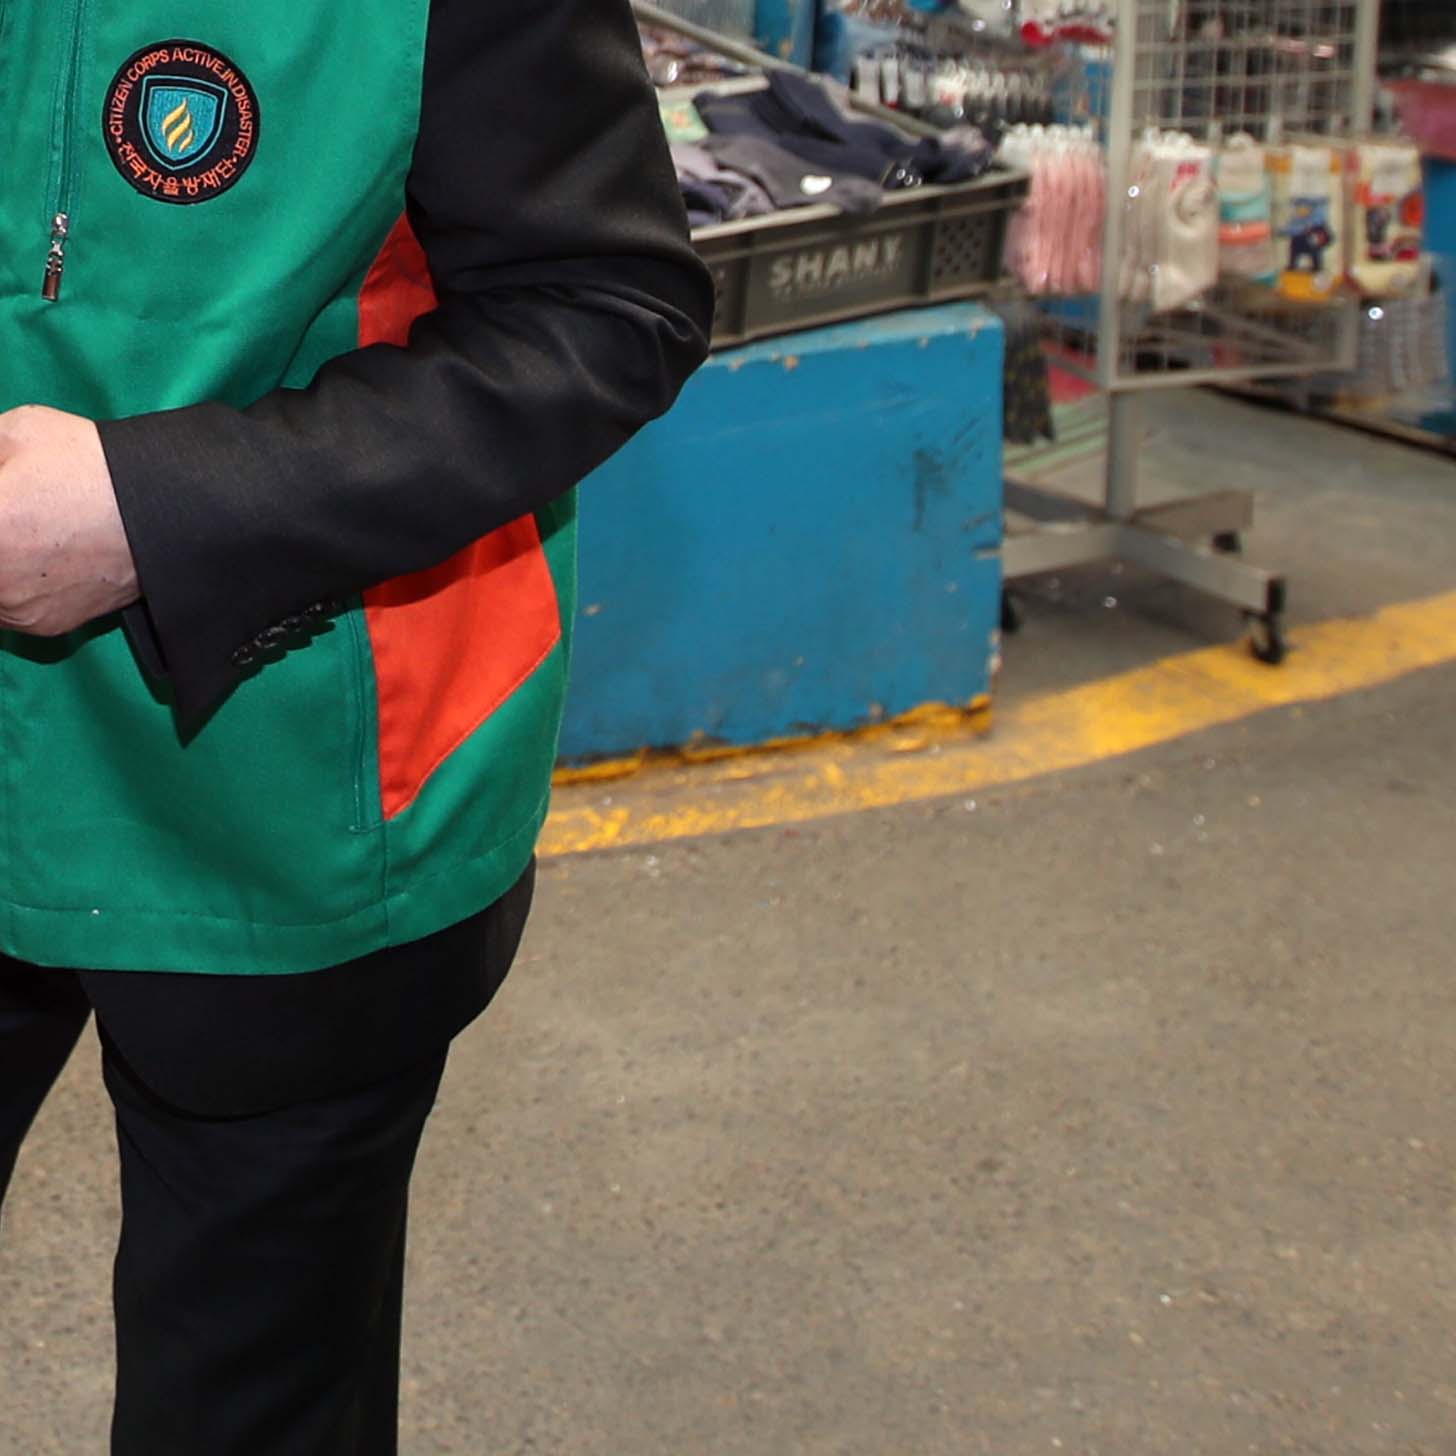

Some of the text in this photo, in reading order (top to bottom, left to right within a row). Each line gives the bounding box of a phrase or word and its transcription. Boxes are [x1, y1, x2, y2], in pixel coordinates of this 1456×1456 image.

[109, 79, 134, 137] CITIZEN
[127, 49, 170, 81] CORPS
[219, 68, 238, 89] IN
[232, 83, 253, 158] DISASTER
